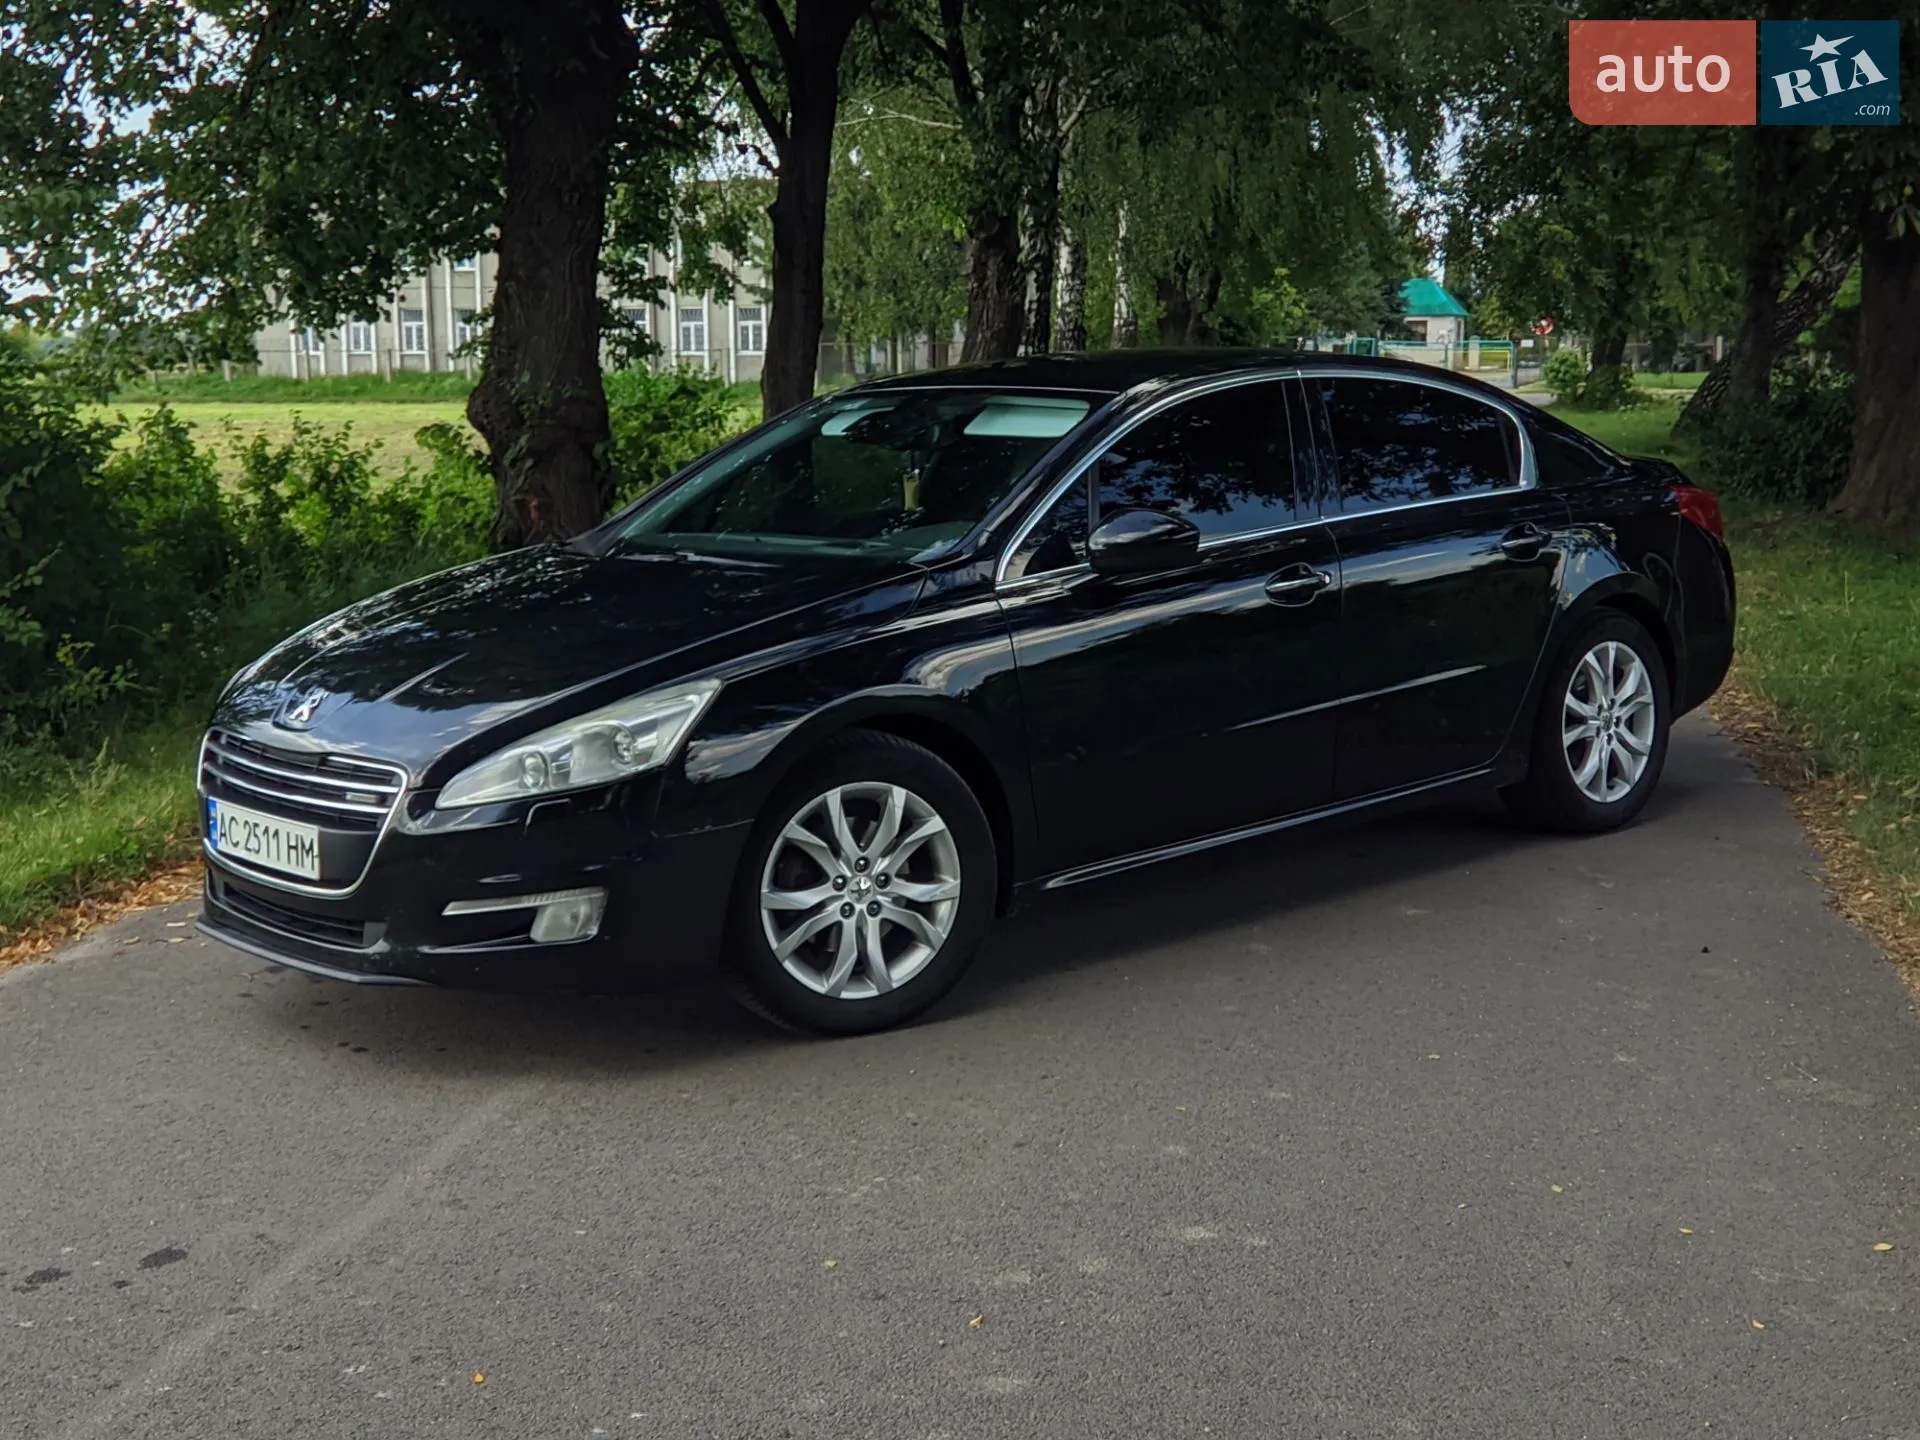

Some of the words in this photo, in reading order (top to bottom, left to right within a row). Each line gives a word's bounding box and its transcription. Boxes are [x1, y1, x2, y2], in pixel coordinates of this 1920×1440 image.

[219, 812, 239, 848] AC
[243, 820, 280, 861] 2511
[287, 831, 315, 871] HM
